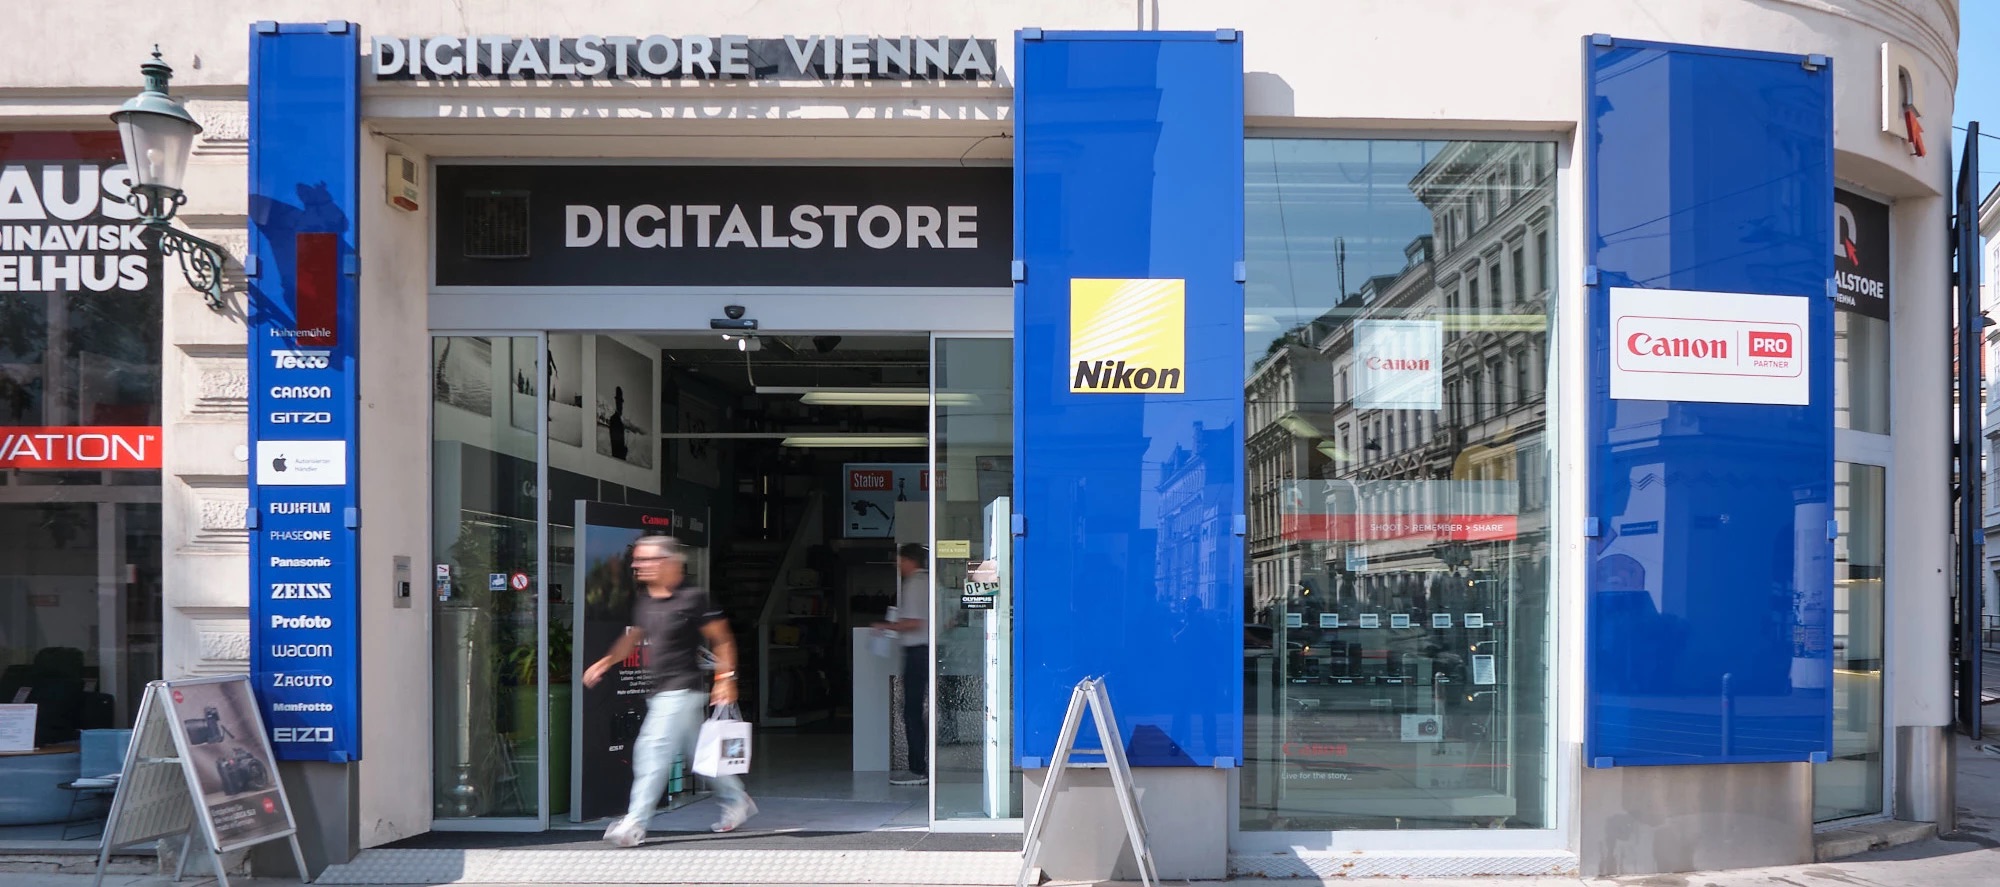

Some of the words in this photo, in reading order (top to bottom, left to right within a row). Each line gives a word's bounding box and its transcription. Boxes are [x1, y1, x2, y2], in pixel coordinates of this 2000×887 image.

[372, 34, 750, 76] DIGITALSTORE
[783, 34, 993, 76] VIENNA
[0, 163, 148, 221] AUS
[565, 203, 978, 249] DIGITALSTORE
[0, 224, 148, 251] INAVISK
[1834, 291, 1856, 307] IENNA
[270, 328, 331, 337] Hahnemühle
[1627, 332, 1727, 359] Canon
[1753, 337, 1788, 353] PRO
[270, 349, 331, 369] Tecco
[1366, 356, 1430, 371] Canon
[1753, 360, 1789, 369] PARTNER
[1074, 360, 1181, 389] Nikon
[270, 412, 332, 424] GITZO
[853, 473, 885, 488] Stative
[270, 502, 331, 514] FUJIFILM
[642, 514, 669, 526] Canon
[270, 557, 331, 567] Panasonic
[271, 583, 332, 599] ZEISS
[271, 615, 332, 628] Profoto
[272, 644, 333, 657] wacom
[273, 703, 333, 712] Manfrotto
[273, 727, 334, 742] EIZO
[1282, 742, 1348, 756] Canon
[1300, 772, 1311, 780] for
[1313, 772, 1326, 780] the
